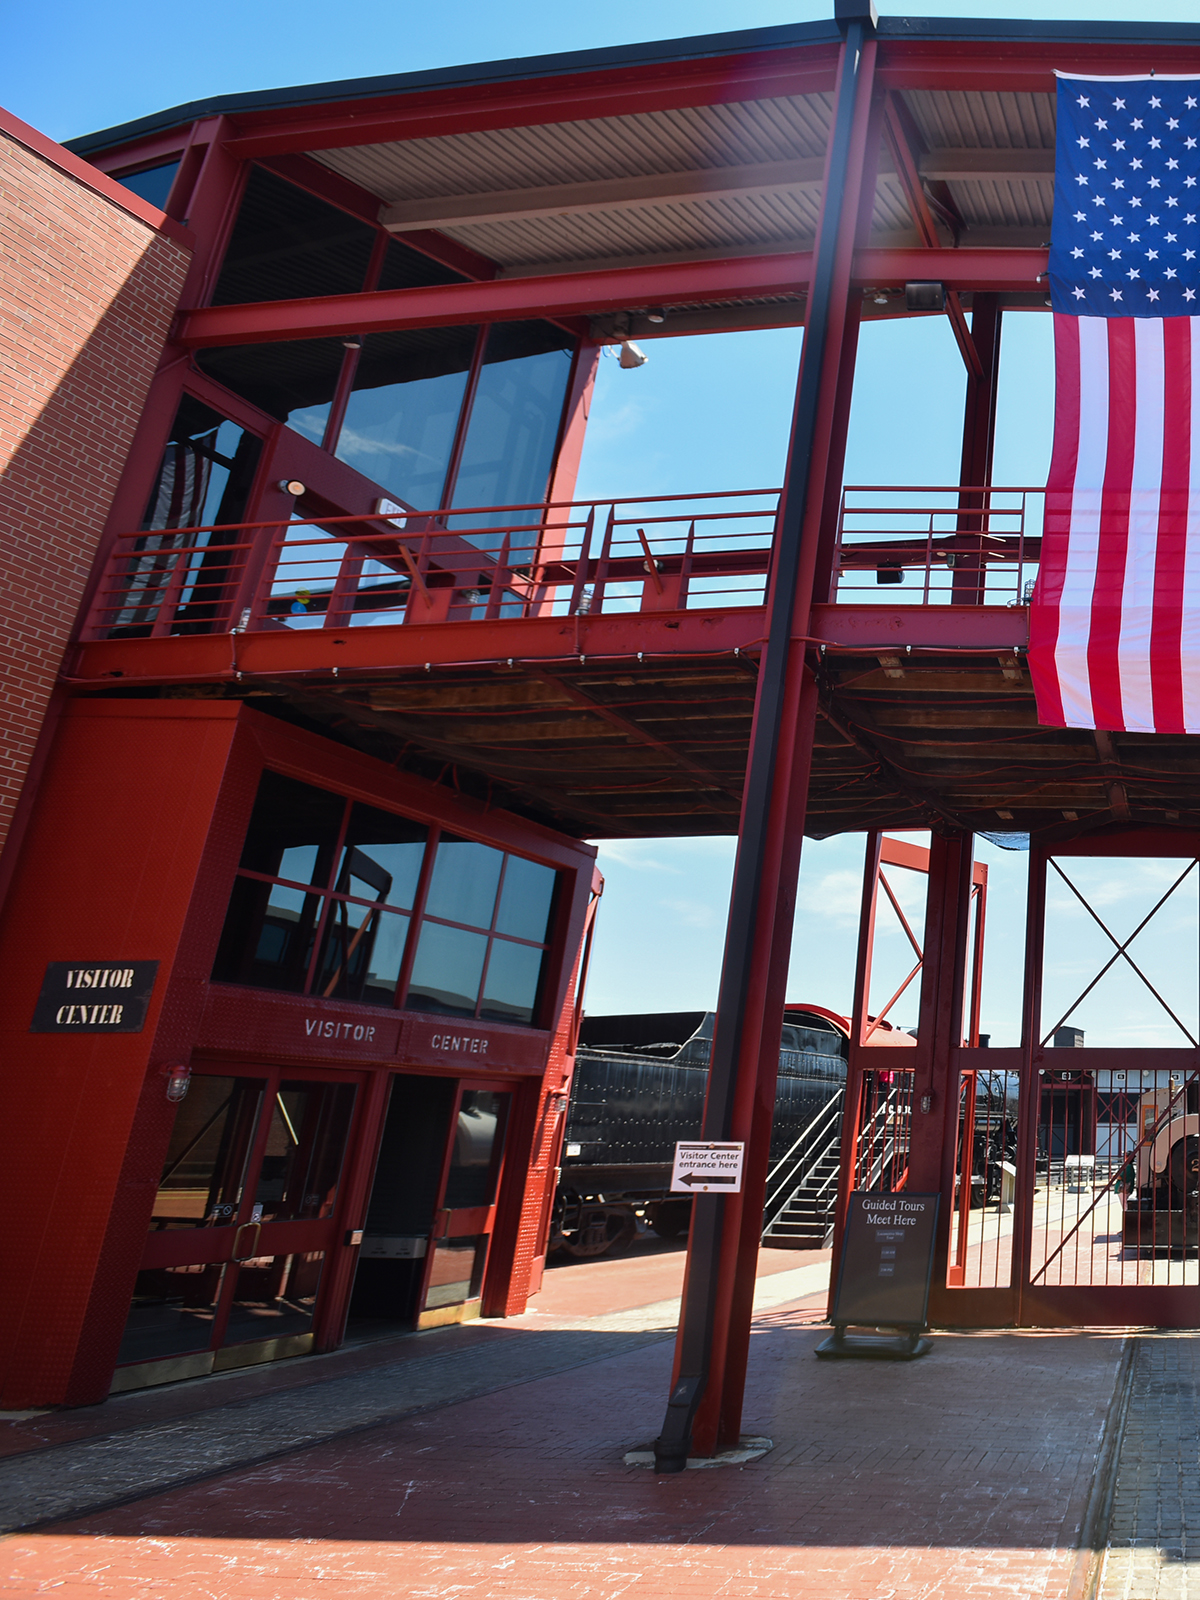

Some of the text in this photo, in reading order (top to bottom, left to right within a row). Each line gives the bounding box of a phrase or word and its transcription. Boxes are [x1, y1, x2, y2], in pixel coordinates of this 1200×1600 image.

[66, 969, 135, 988] VISITOR
[56, 1004, 124, 1025] CENTER
[305, 1018, 489, 1054] VISITOR CENTER
[680, 1151, 739, 1160] Visitor Center
[718, 1161, 738, 1169] here
[861, 1199, 925, 1212] Guided Tours
[866, 1213, 917, 1226] Meet Here
